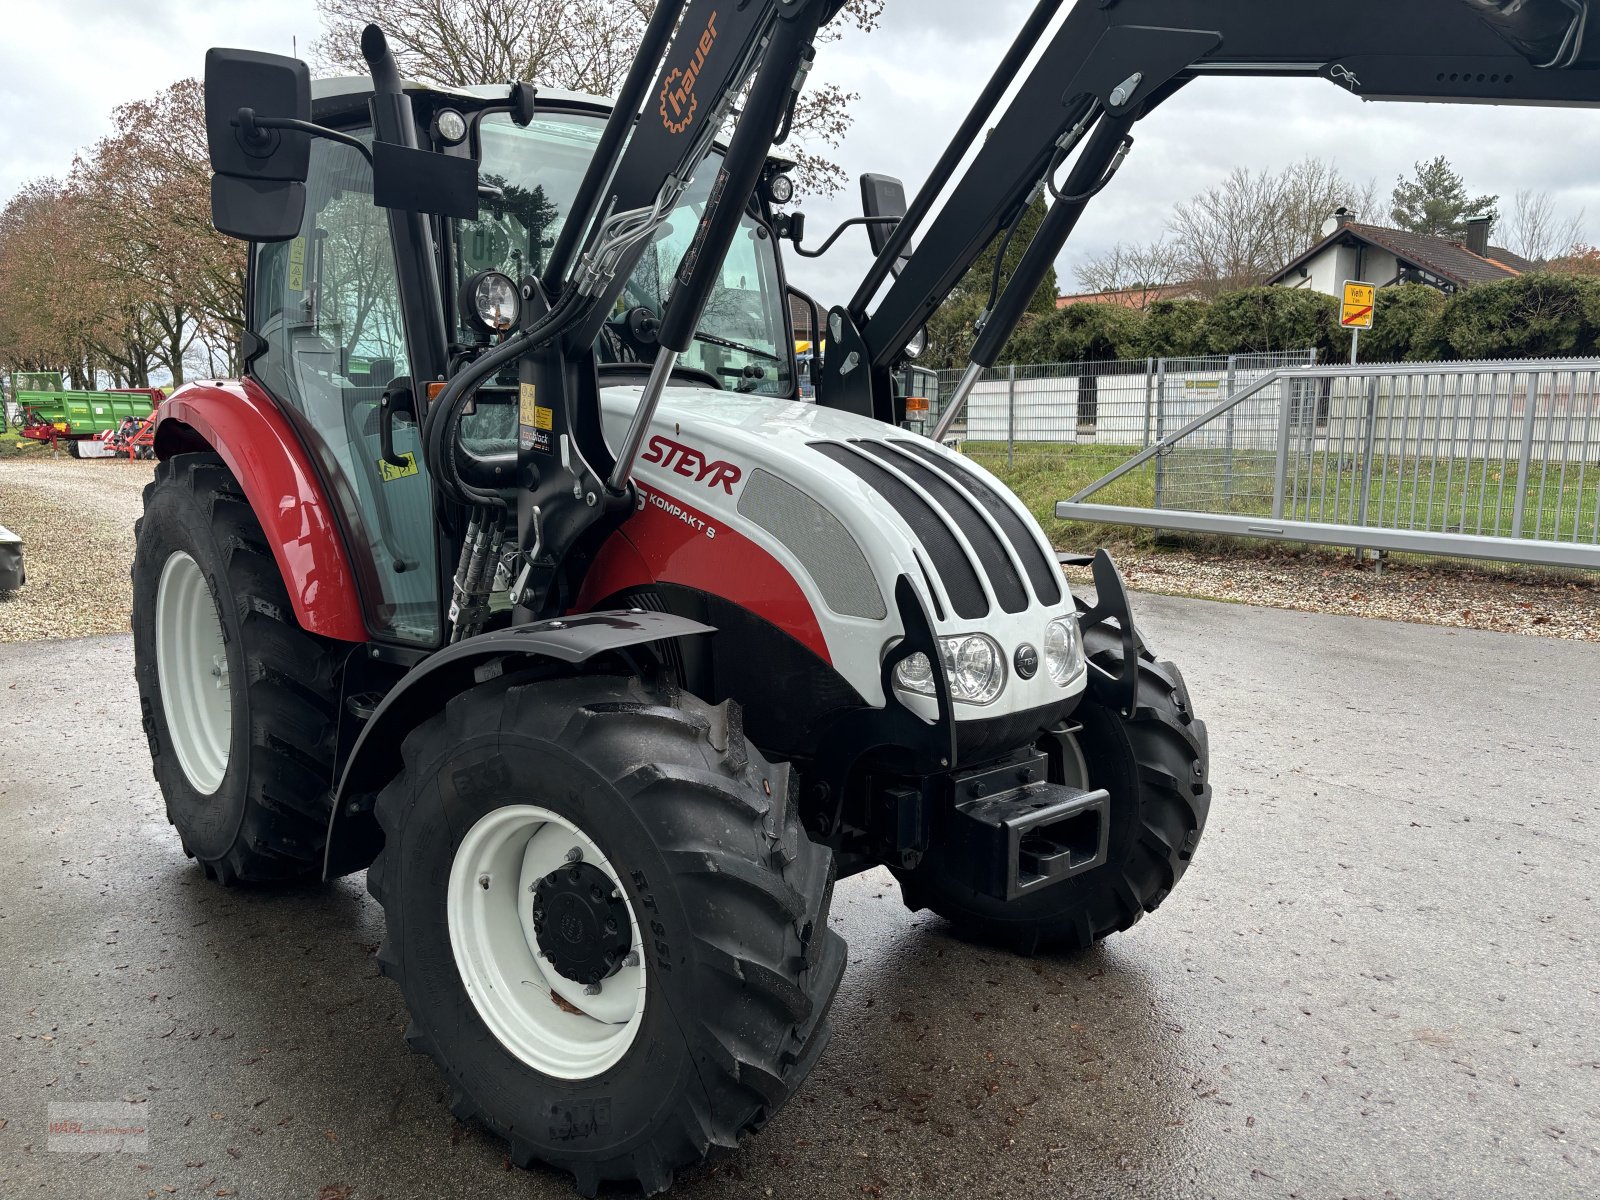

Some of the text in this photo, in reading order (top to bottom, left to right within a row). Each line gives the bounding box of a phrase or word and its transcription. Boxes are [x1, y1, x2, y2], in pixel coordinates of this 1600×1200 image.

[669, 10, 717, 116] hauer
[641, 435, 742, 495] STEYR
[649, 493, 705, 531] KOMPAKT
[706, 526, 716, 539] S
